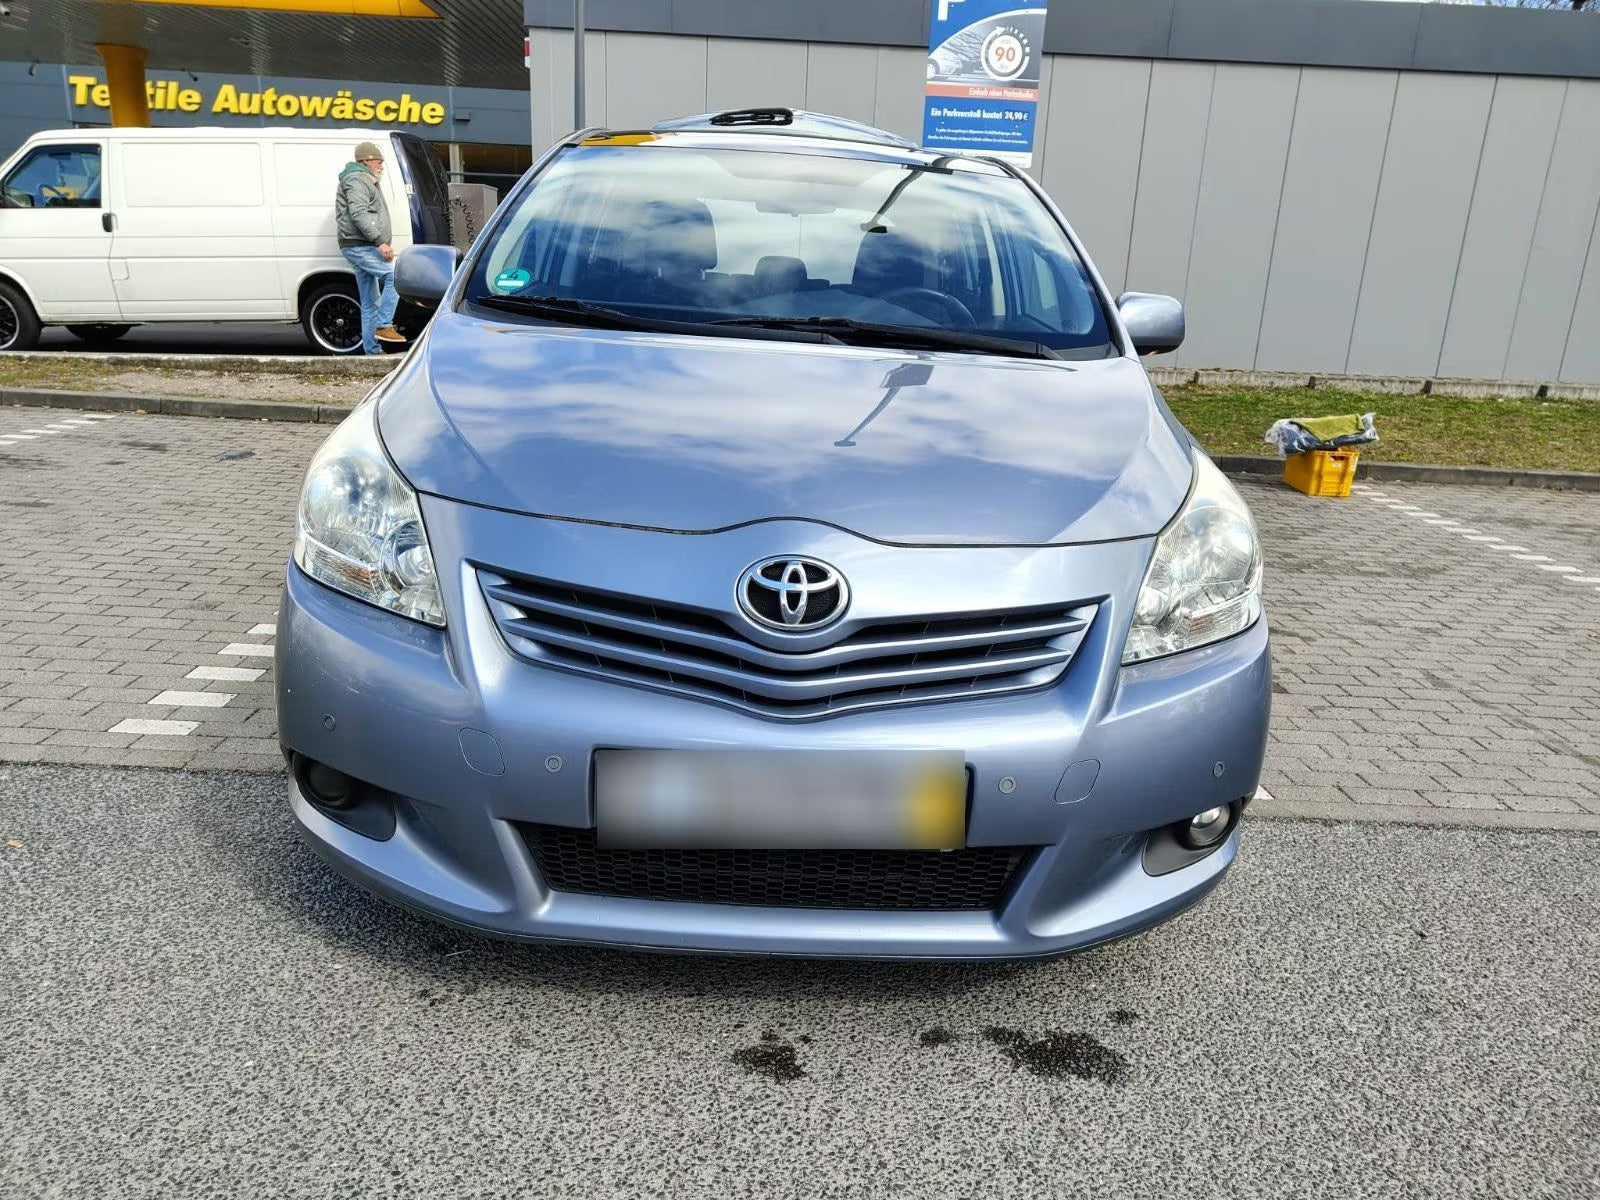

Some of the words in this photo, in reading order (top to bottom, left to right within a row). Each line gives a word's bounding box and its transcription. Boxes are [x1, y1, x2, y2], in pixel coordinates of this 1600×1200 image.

[995, 46, 1016, 62] 90
[68, 75, 203, 112] Tetile
[211, 83, 445, 125] Autowäsche
[931, 107, 942, 117] Ein
[942, 108, 981, 118] Parkverstoß
[982, 110, 1002, 119] kostet
[1004, 111, 1022, 121] 24,90
[509, 270, 518, 280] 4
